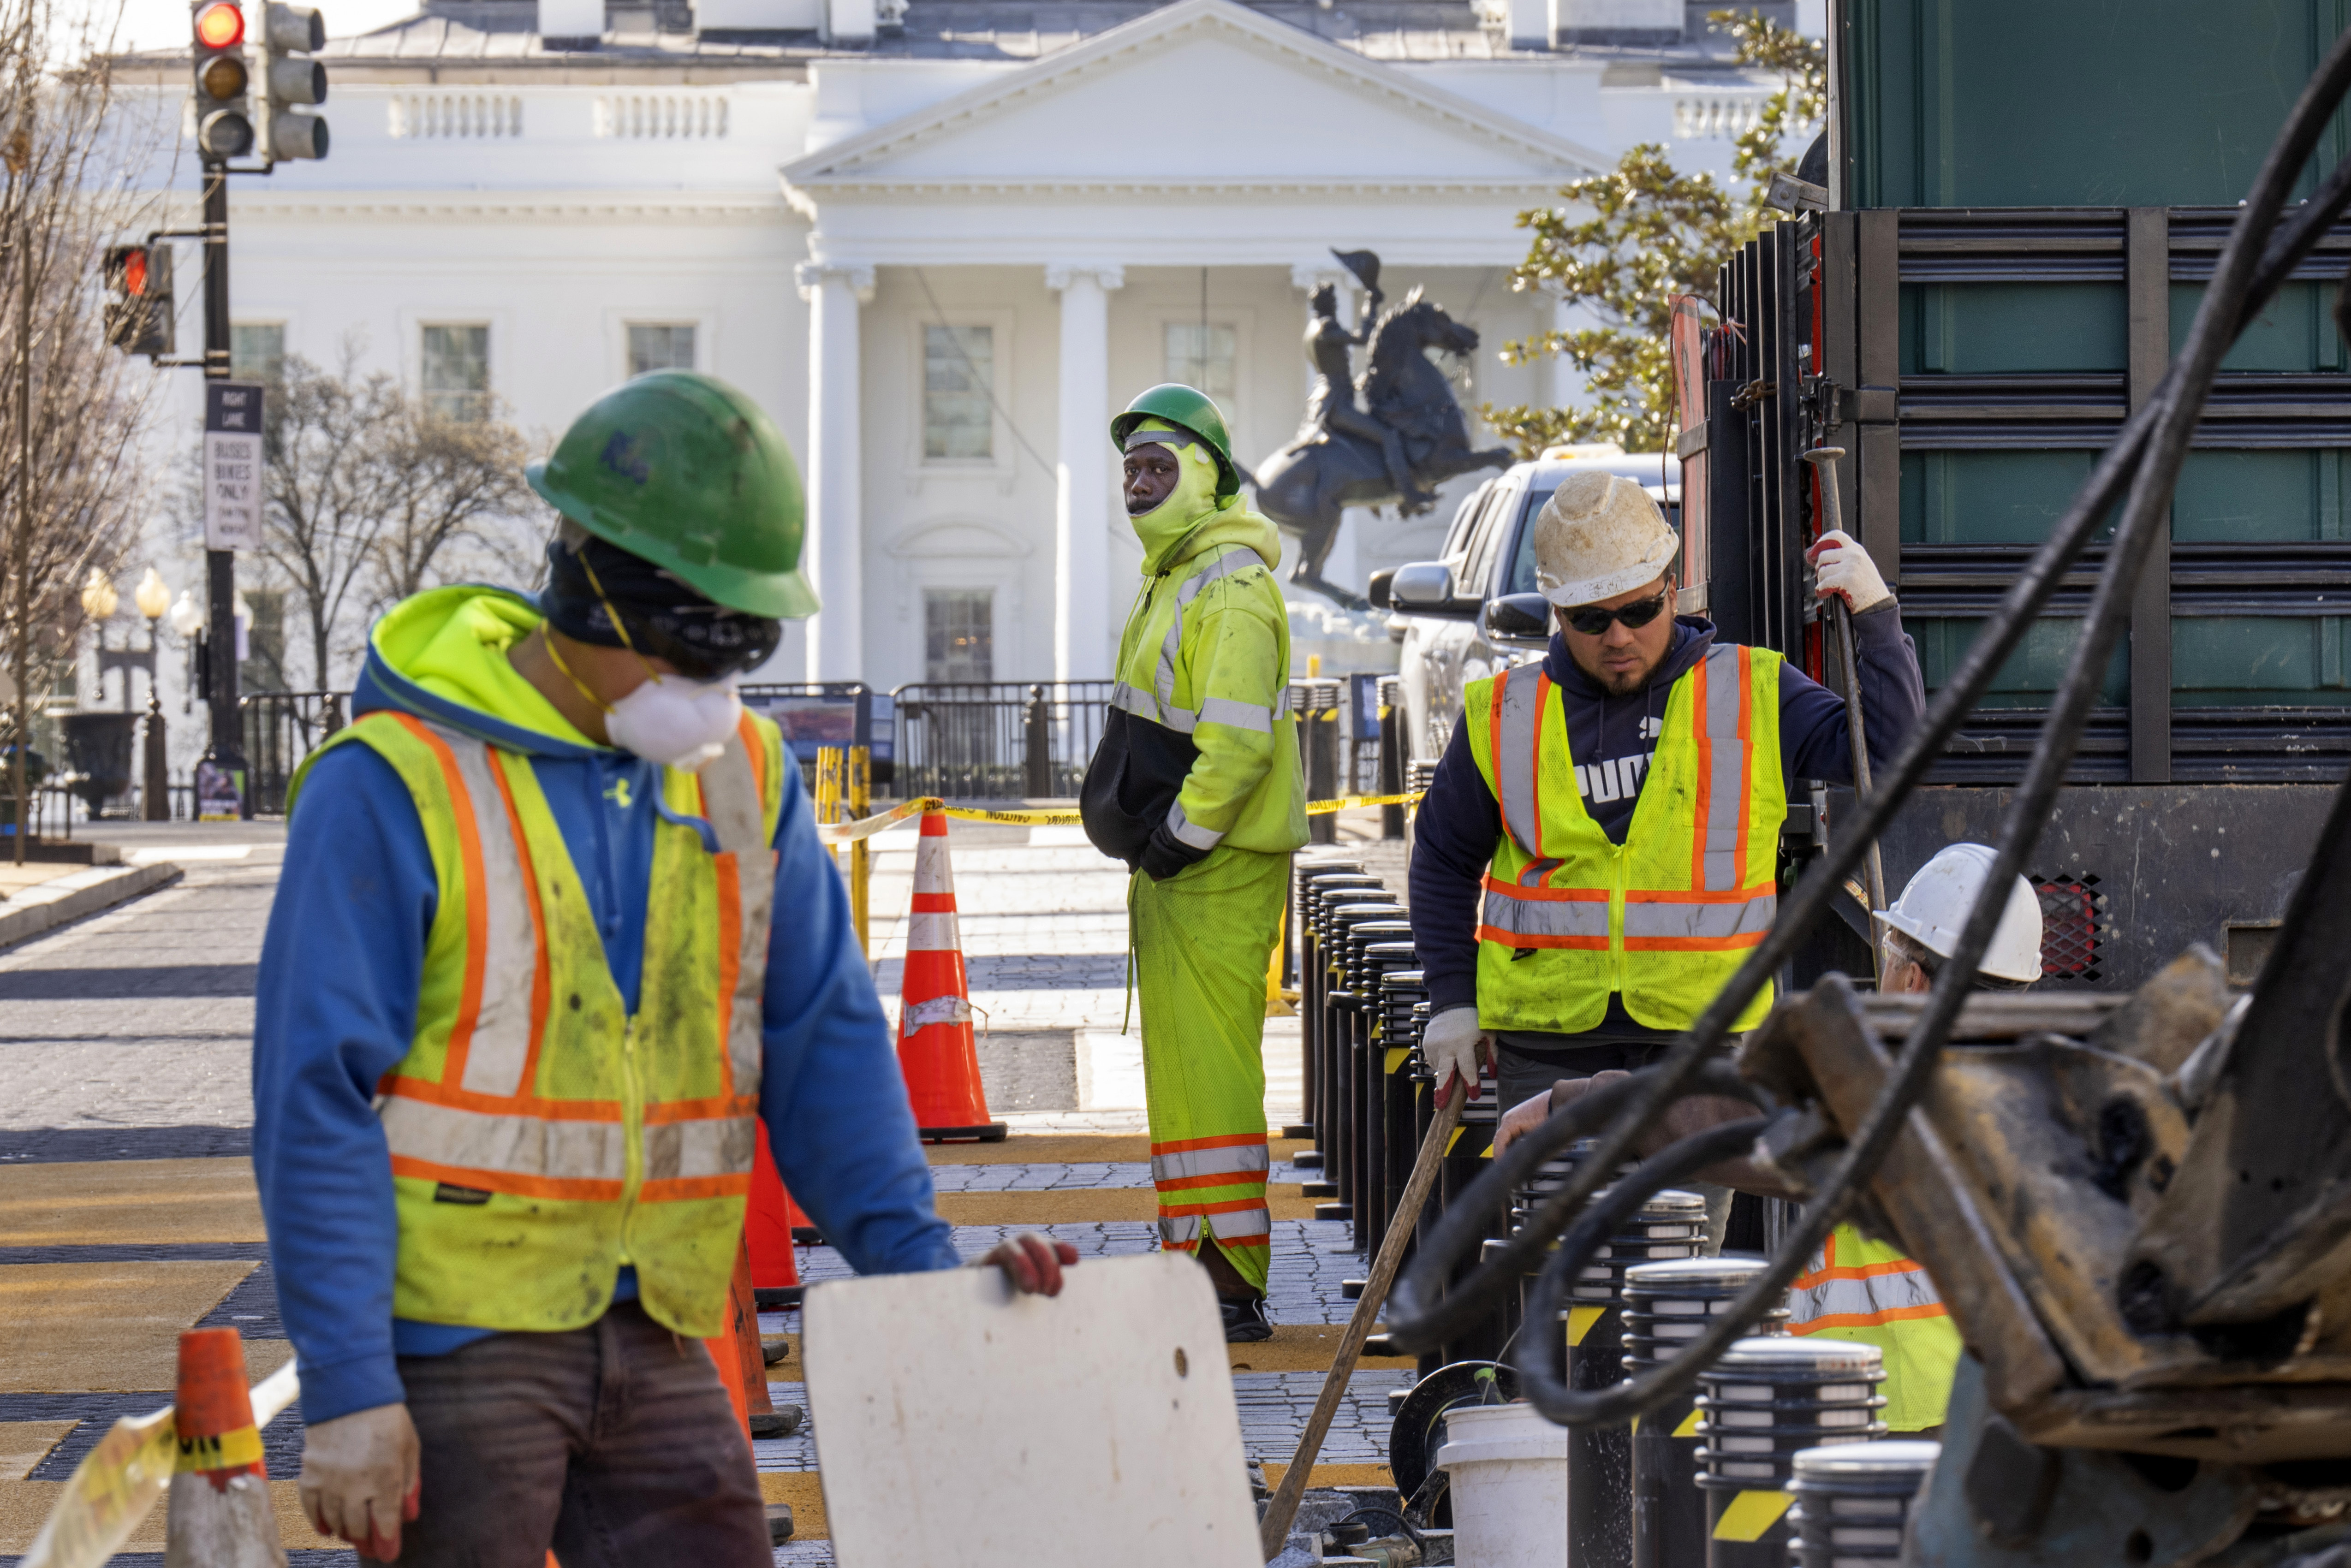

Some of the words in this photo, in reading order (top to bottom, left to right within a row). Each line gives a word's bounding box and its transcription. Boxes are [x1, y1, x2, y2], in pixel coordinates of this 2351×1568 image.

[222, 391, 247, 407] RIGHT
[222, 412, 245, 427] LANE
[216, 483, 250, 501] ONLY
[1573, 752, 1655, 803] UM
[986, 810, 1030, 823] CAUTION
